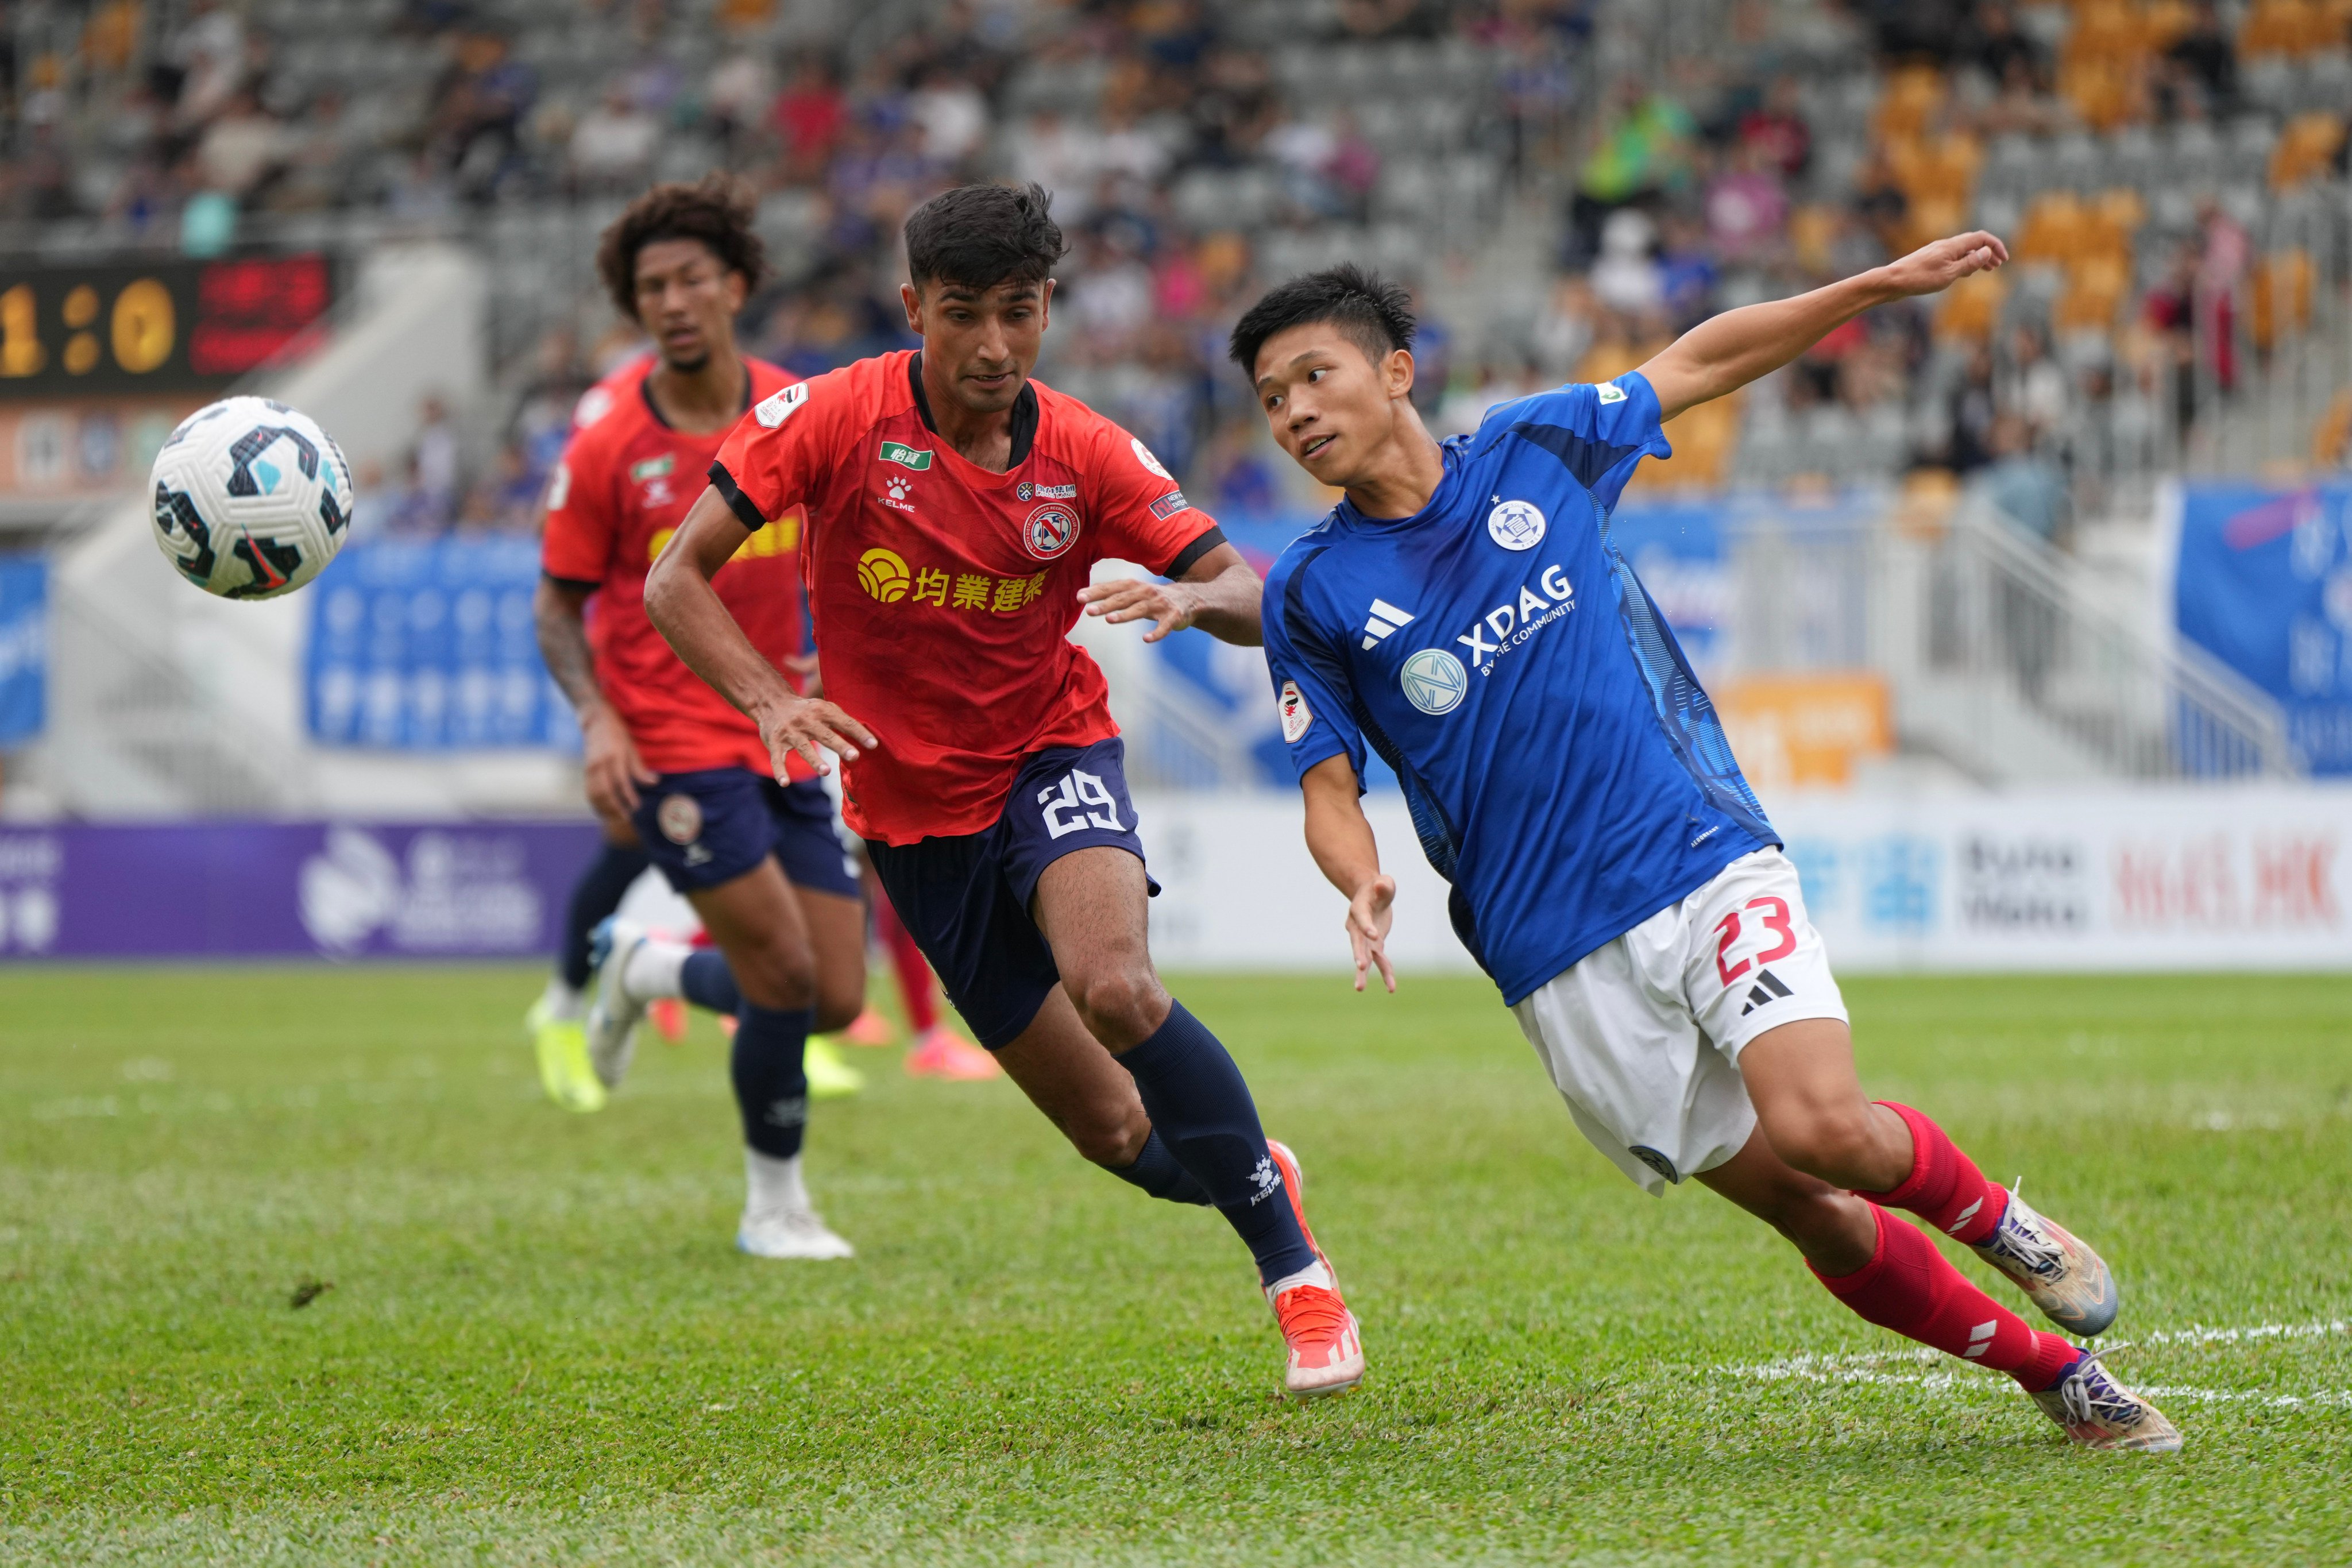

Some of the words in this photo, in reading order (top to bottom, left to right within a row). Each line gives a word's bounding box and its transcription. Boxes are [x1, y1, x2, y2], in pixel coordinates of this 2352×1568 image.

[878, 497, 915, 513] KELME
[1167, 493, 1178, 502] NEW
[1026, 516, 1034, 536] DISTRICT
[1034, 507, 1049, 517] SOCCER
[1050, 506, 1072, 518] RECREATION
[1068, 527, 1076, 543] LIMITED
[1490, 511, 1499, 529] EASTERN
[1457, 565, 1574, 667] XDAG
[1480, 659, 1494, 677] BY
[1496, 641, 1512, 657] HE
[1512, 599, 1575, 645] COMMUNITY
[1037, 769, 1127, 840] 29
[1690, 825, 1719, 848] AEROREADY
[1713, 897, 1797, 988] 23
[1250, 1173, 1282, 1207] KELME
